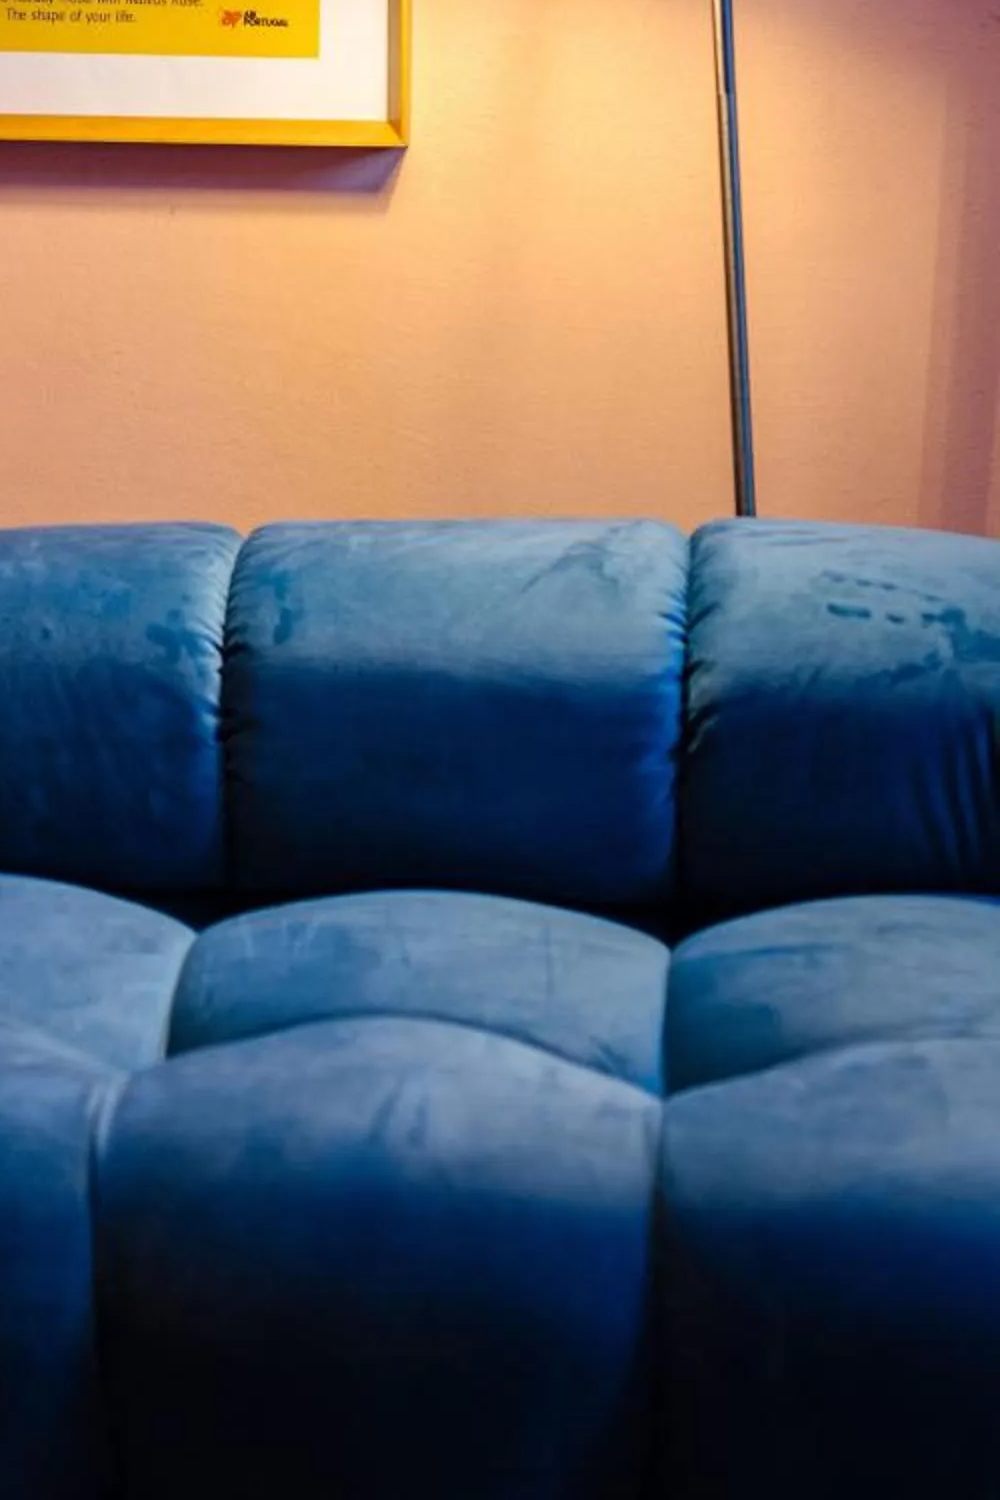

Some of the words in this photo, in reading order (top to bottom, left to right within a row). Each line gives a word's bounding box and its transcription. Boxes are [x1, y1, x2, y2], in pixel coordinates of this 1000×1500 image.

[7, 8, 27, 21] The
[31, 8, 65, 24] shape
[69, 9, 82, 21] of
[85, 11, 112, 25] your
[115, 10, 137, 23] life.
